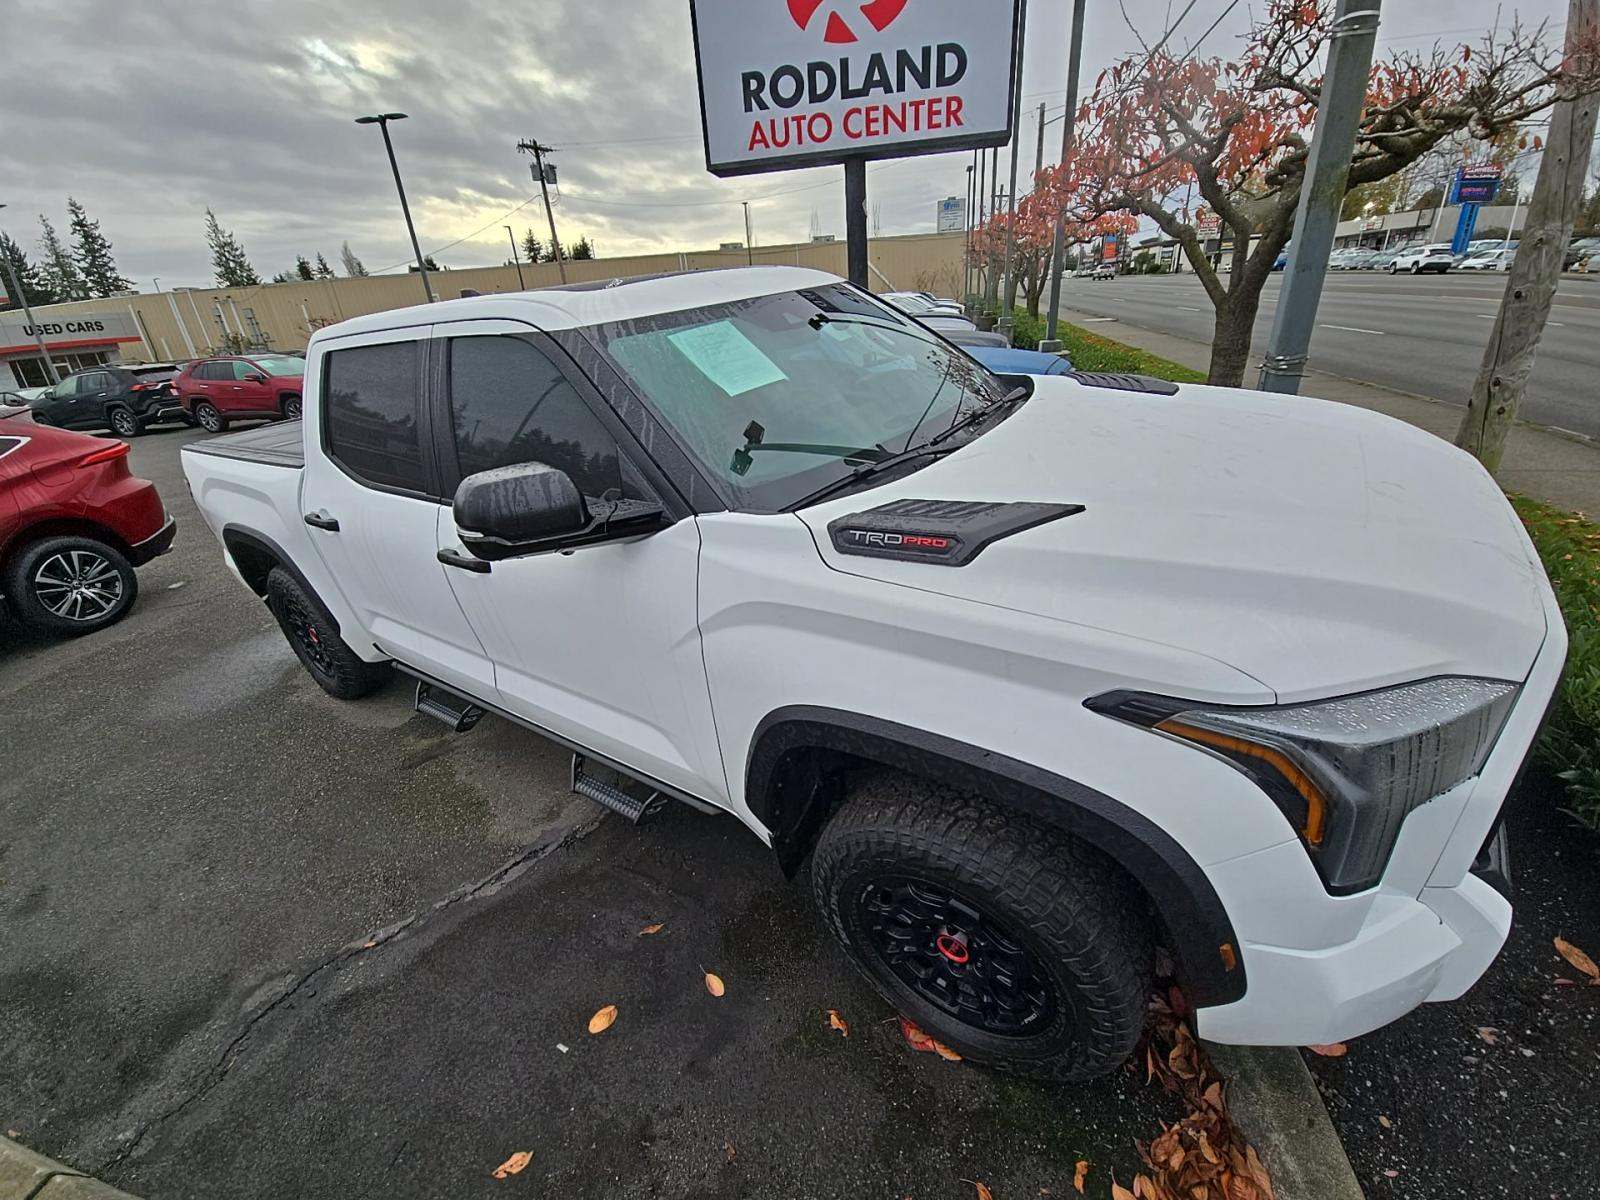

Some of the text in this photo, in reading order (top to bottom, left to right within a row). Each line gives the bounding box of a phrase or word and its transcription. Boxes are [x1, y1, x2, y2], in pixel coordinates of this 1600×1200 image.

[741, 42, 968, 113] RODLAND
[748, 95, 965, 151] AUTO CENTER
[23, 321, 105, 337] USED CARS
[849, 530, 948, 548] TRD PRO
